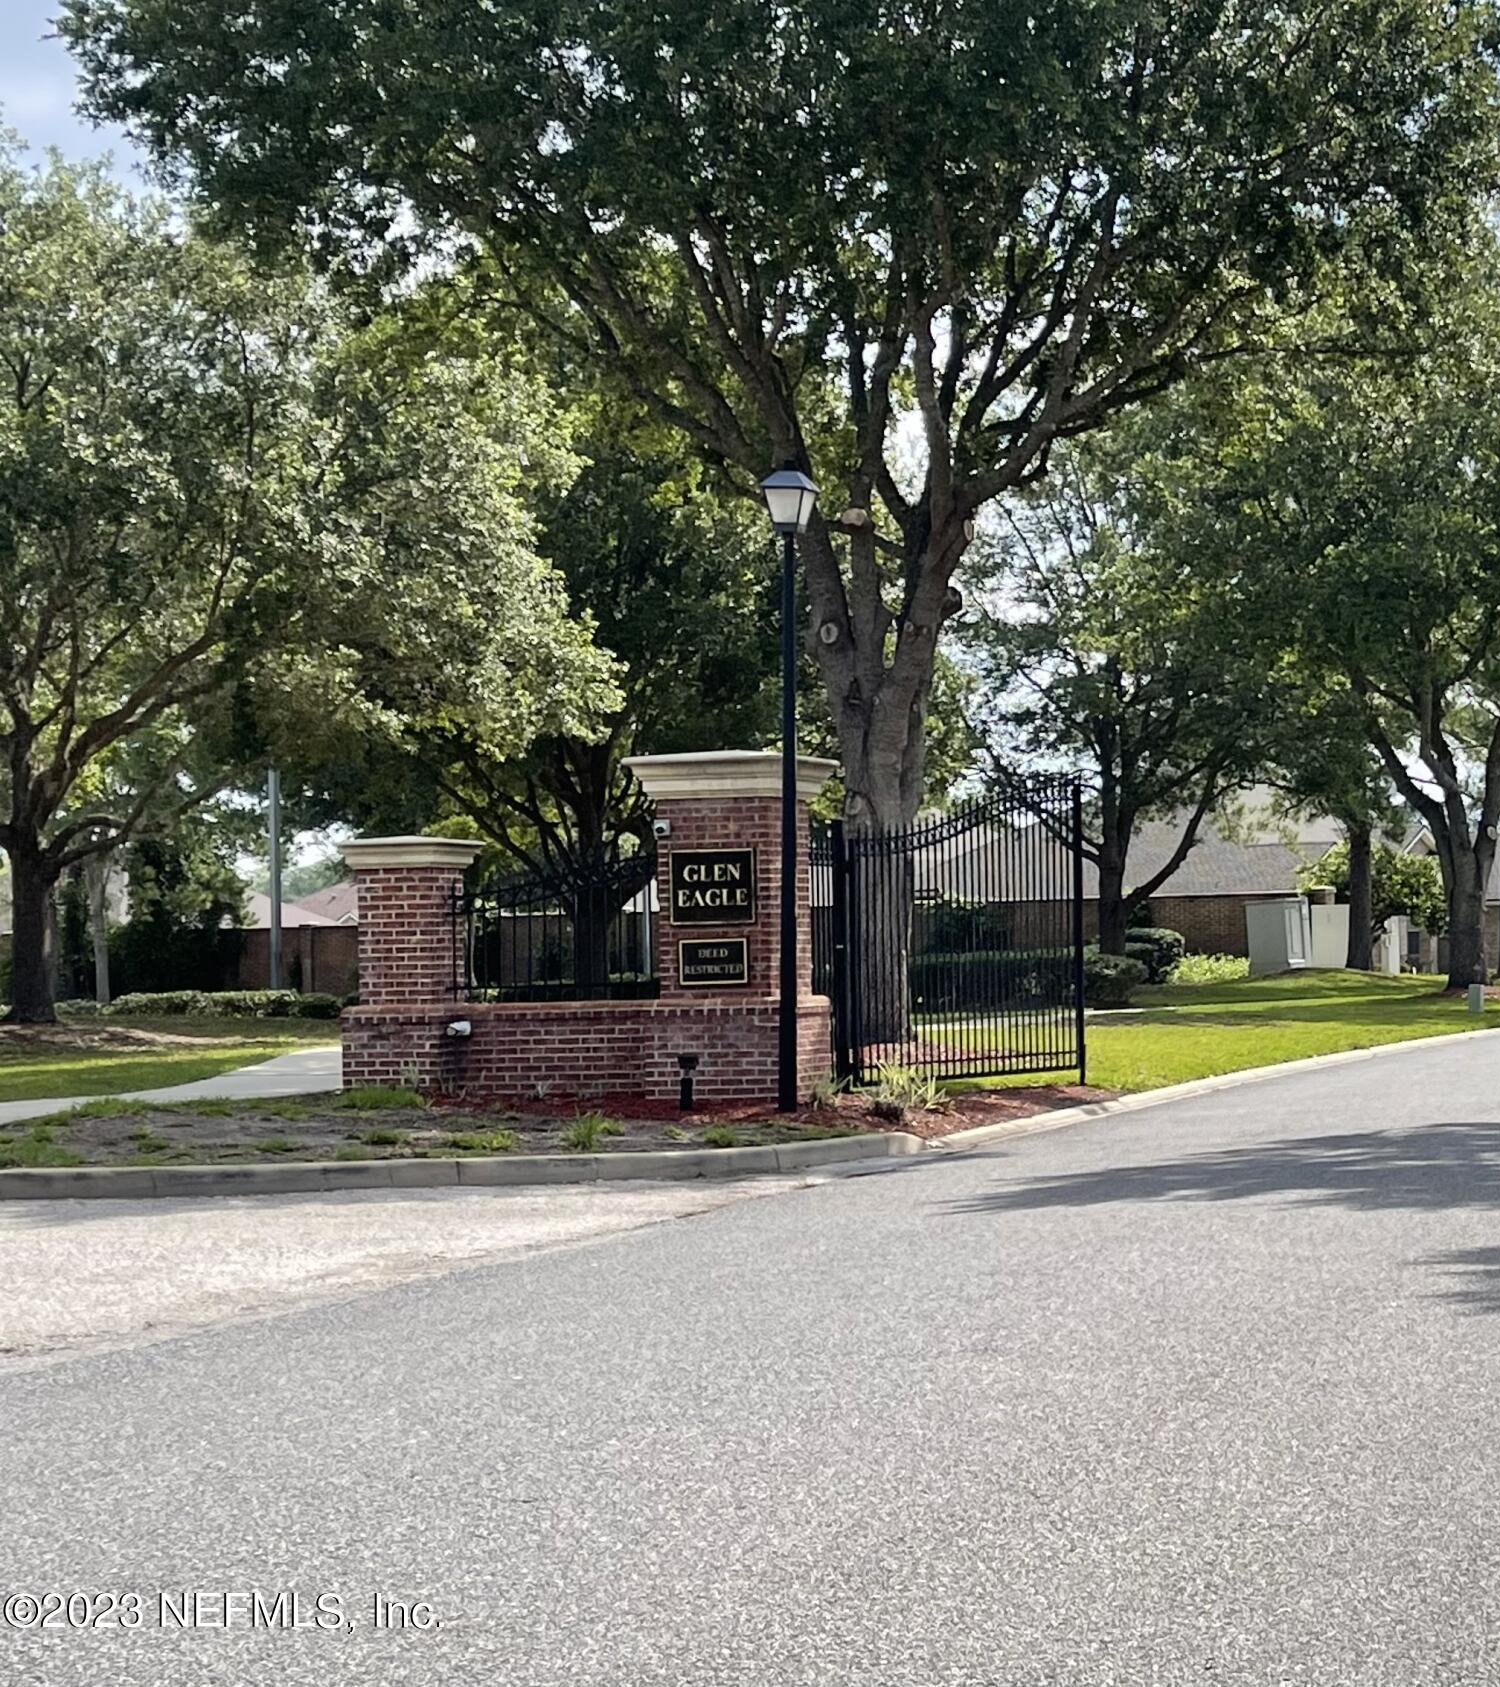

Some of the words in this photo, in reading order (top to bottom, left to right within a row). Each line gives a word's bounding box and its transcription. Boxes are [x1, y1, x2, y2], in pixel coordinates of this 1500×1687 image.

[683, 864, 740, 882] GLEN
[678, 889, 747, 907] EAGLE
[698, 948, 728, 958] DEED
[684, 963, 744, 975] RESTRICTED
